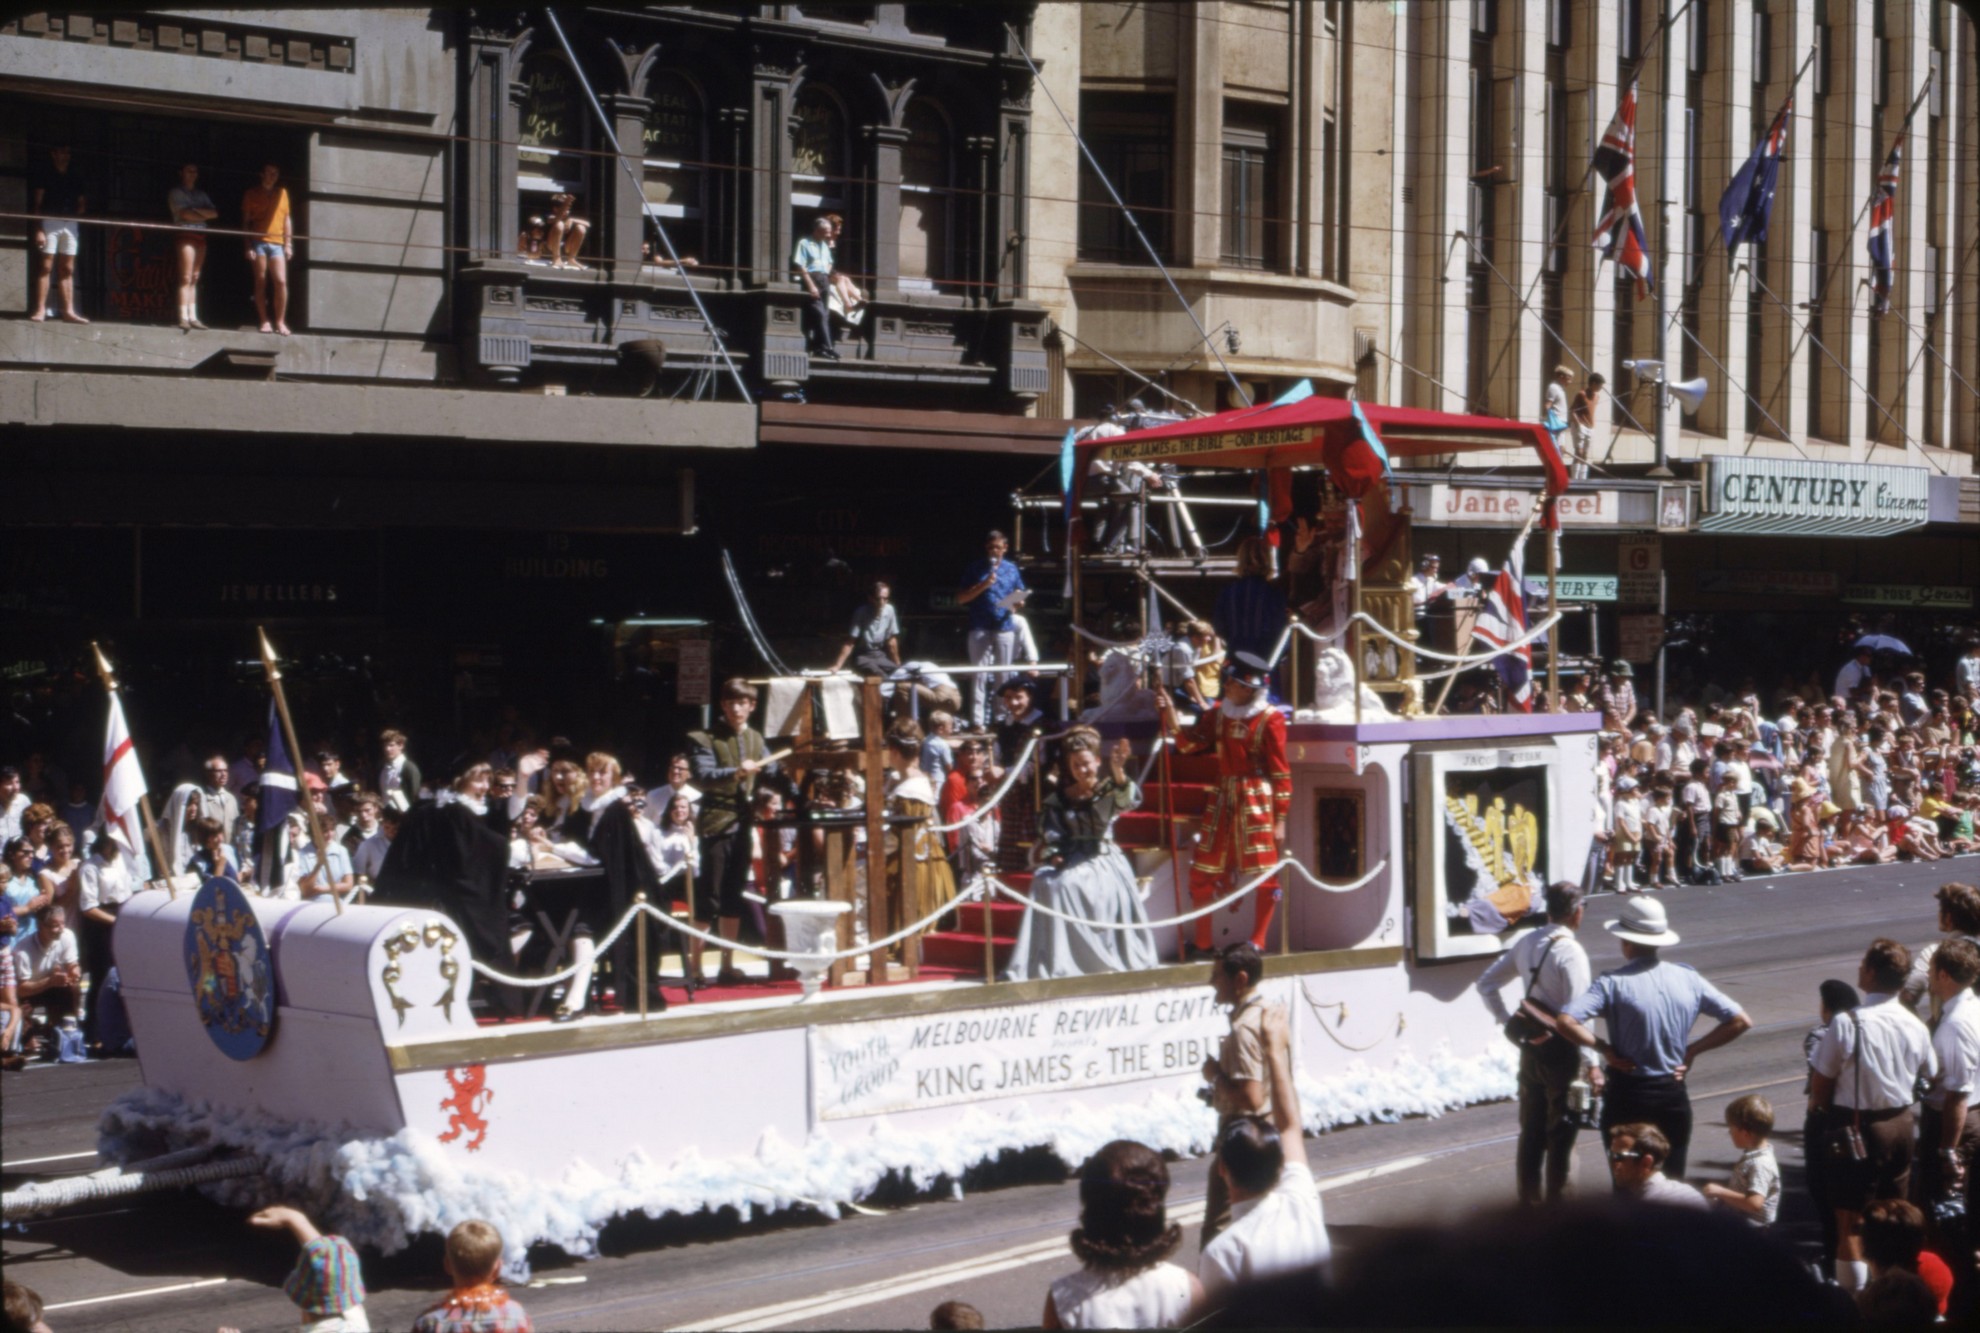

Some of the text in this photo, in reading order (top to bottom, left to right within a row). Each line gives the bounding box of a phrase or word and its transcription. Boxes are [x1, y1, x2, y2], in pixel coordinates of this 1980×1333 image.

[653, 93, 688, 108] REAL
[1111, 446, 1137, 459] KING
[1139, 442, 1170, 456] JAMES
[1179, 439, 1197, 453] THE
[1199, 435, 1223, 451] BIBLE
[1235, 432, 1255, 447] OUR
[1257, 428, 1304, 445] HERITAGE
[1446, 488, 1520, 514] Jane
[1723, 473, 1928, 511] CENTURY Cinema
[816, 509, 859, 529] CITY
[506, 559, 607, 577] BUILDING
[221, 584, 337, 600] JEWELLERS
[910, 1012, 1039, 1050] MELBOURNE
[1053, 1003, 1141, 1036] REVIVAL
[827, 1035, 889, 1084] YOUTH
[915, 1062, 985, 1099] KING
[995, 1053, 1072, 1090] JAMES
[1084, 1060, 1101, 1080] &
[1107, 1043, 1150, 1077] THE
[840, 1056, 900, 1105] GROUP
